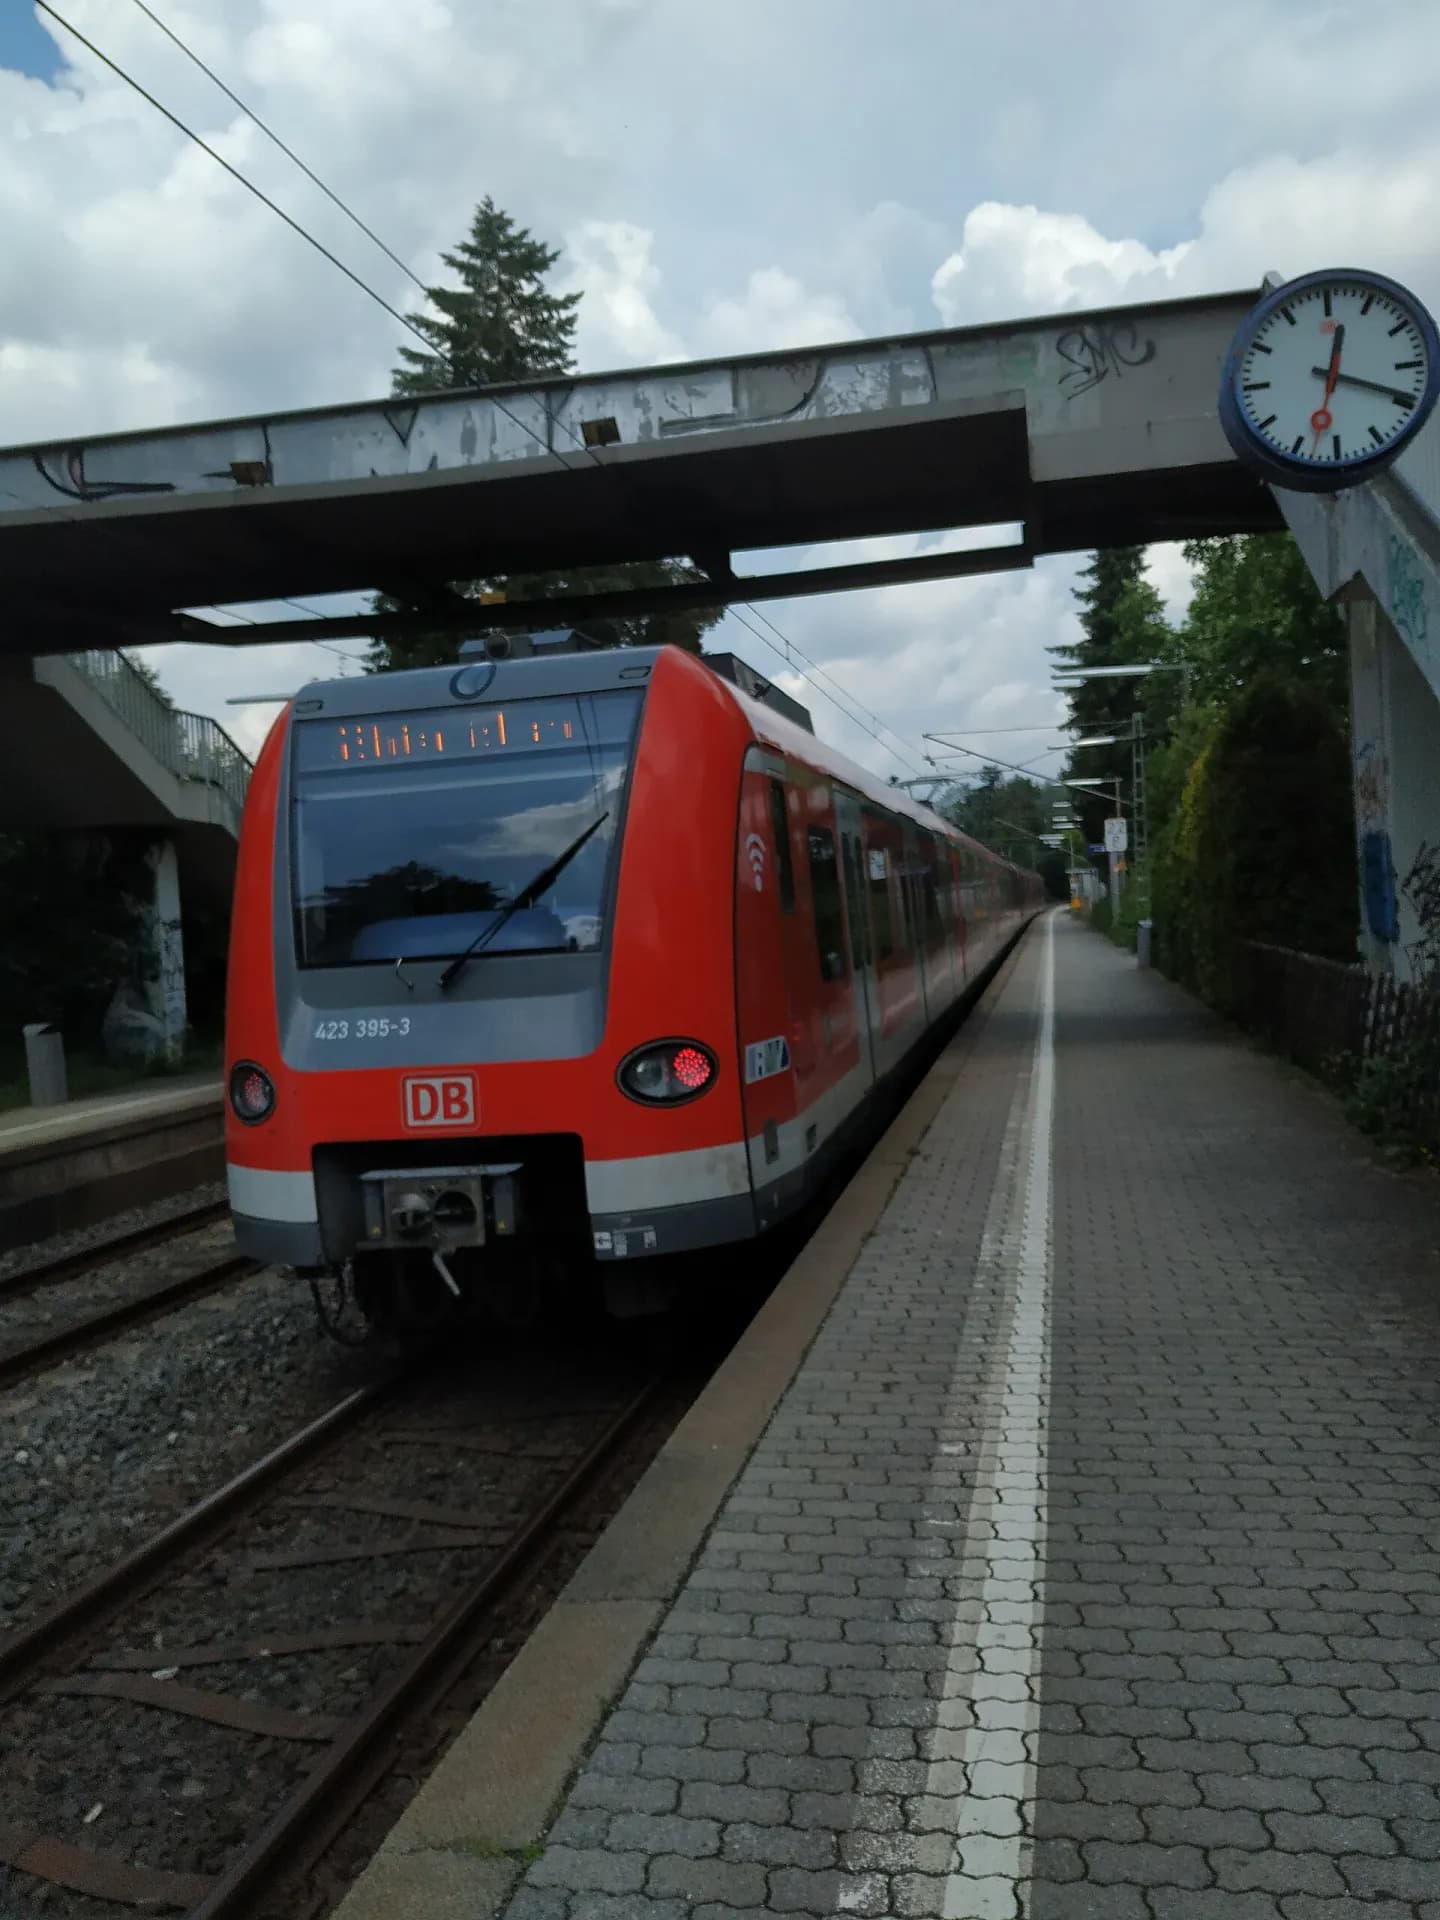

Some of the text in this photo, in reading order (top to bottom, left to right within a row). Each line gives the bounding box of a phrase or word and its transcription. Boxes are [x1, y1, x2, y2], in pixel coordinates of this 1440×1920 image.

[314, 1017, 411, 1040] 423 395-3
[410, 1080, 471, 1122] DB
